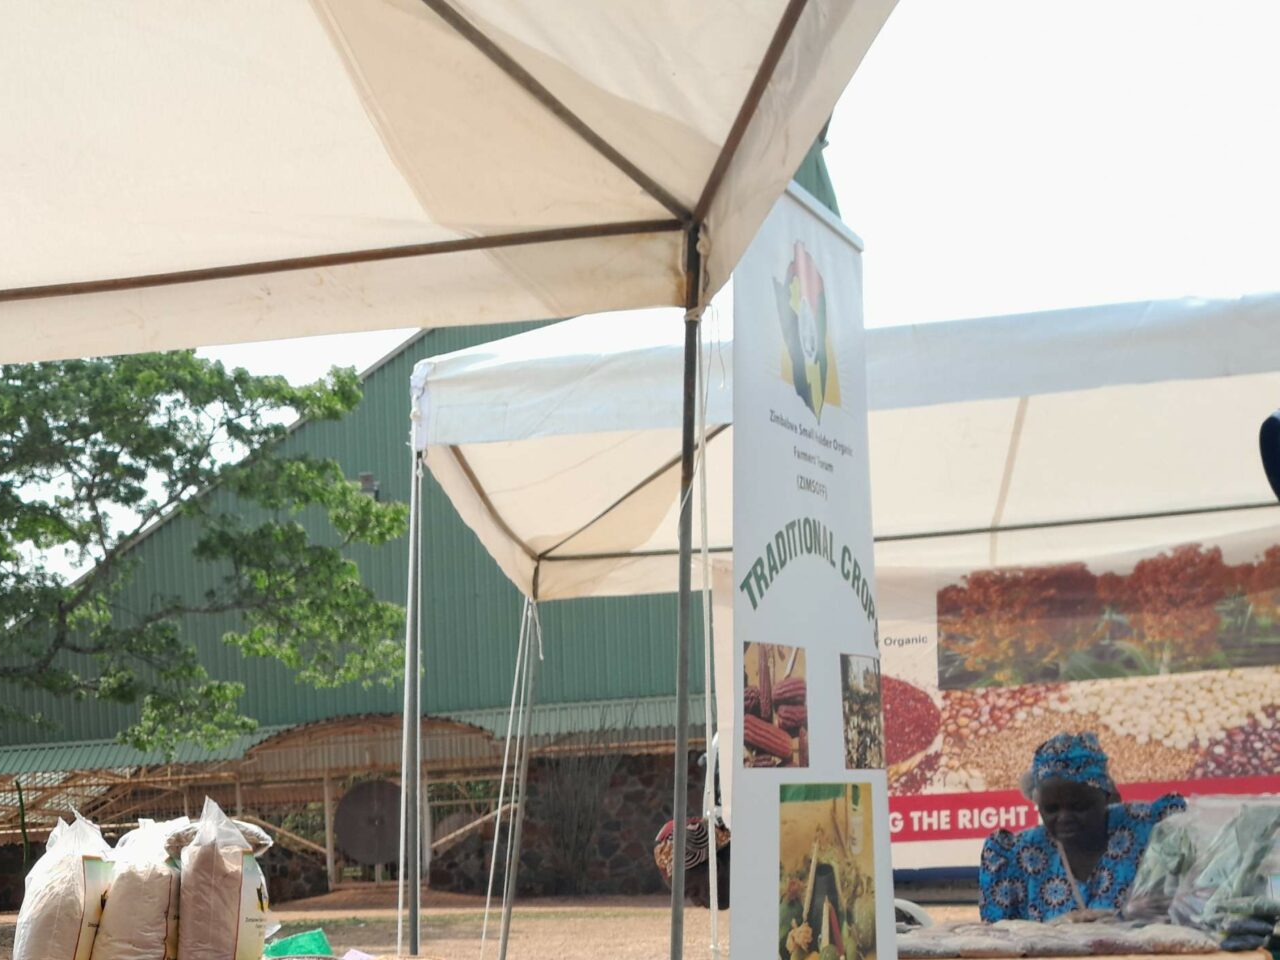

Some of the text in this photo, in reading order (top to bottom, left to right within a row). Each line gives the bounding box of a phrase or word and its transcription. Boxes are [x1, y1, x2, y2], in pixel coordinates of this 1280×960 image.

[739, 517, 836, 611] TRADITIONAL
[884, 634, 928, 648] Organic
[888, 811, 904, 833] G
[909, 809, 951, 832] THE
[957, 805, 1029, 830] RIGHT
